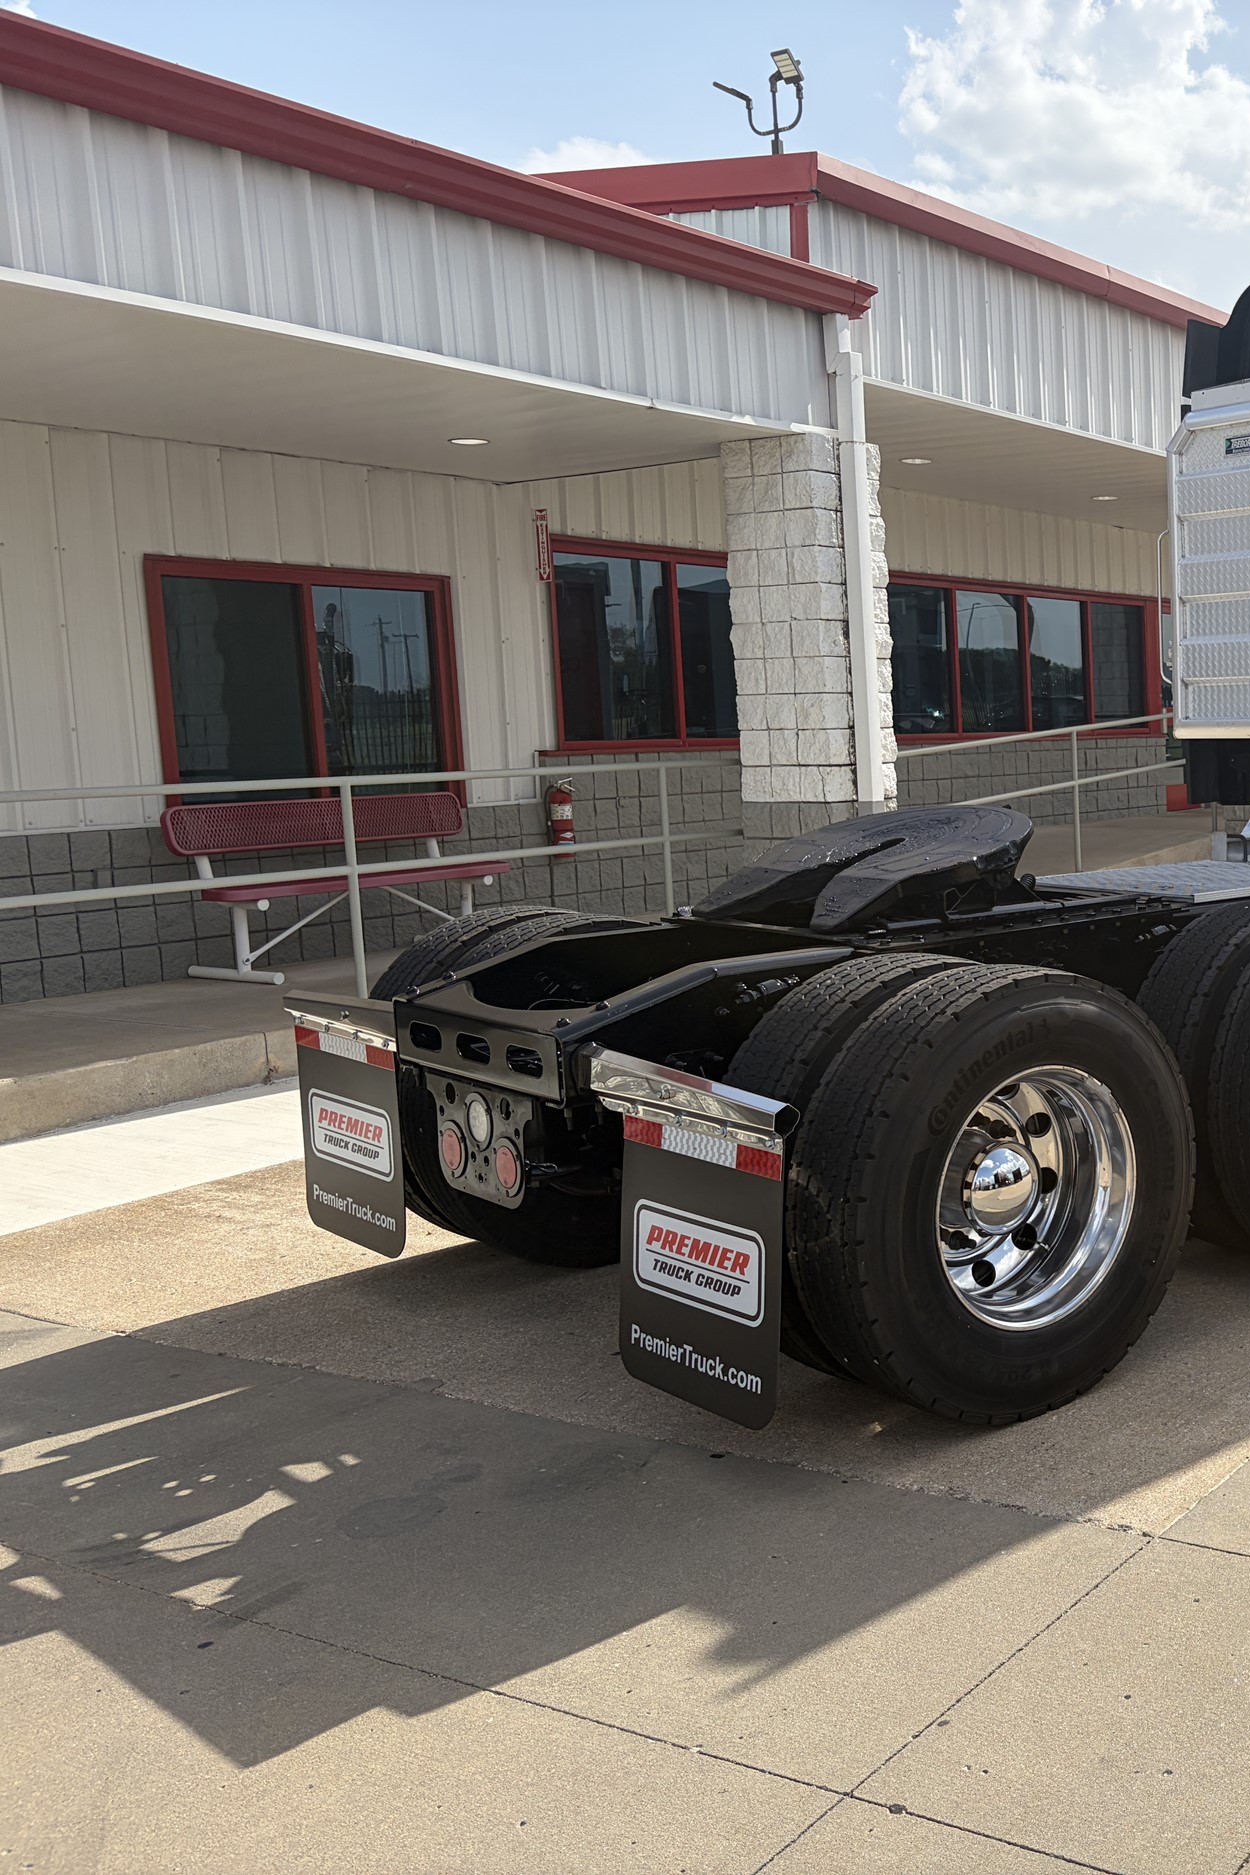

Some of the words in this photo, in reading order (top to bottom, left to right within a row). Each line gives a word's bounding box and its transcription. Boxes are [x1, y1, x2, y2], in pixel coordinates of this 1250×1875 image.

[927, 1021, 1034, 1137] Continental
[318, 1107, 384, 1144] PREMIER
[323, 1133, 350, 1151] TRUCK
[351, 1143, 380, 1160] GROUP
[313, 1183, 396, 1232] PremierTruck.com
[646, 1224, 751, 1277] PREMIER
[653, 1257, 694, 1283] TRUCK
[695, 1272, 742, 1298] GROUP
[631, 1323, 762, 1395] PremierTruck.com
